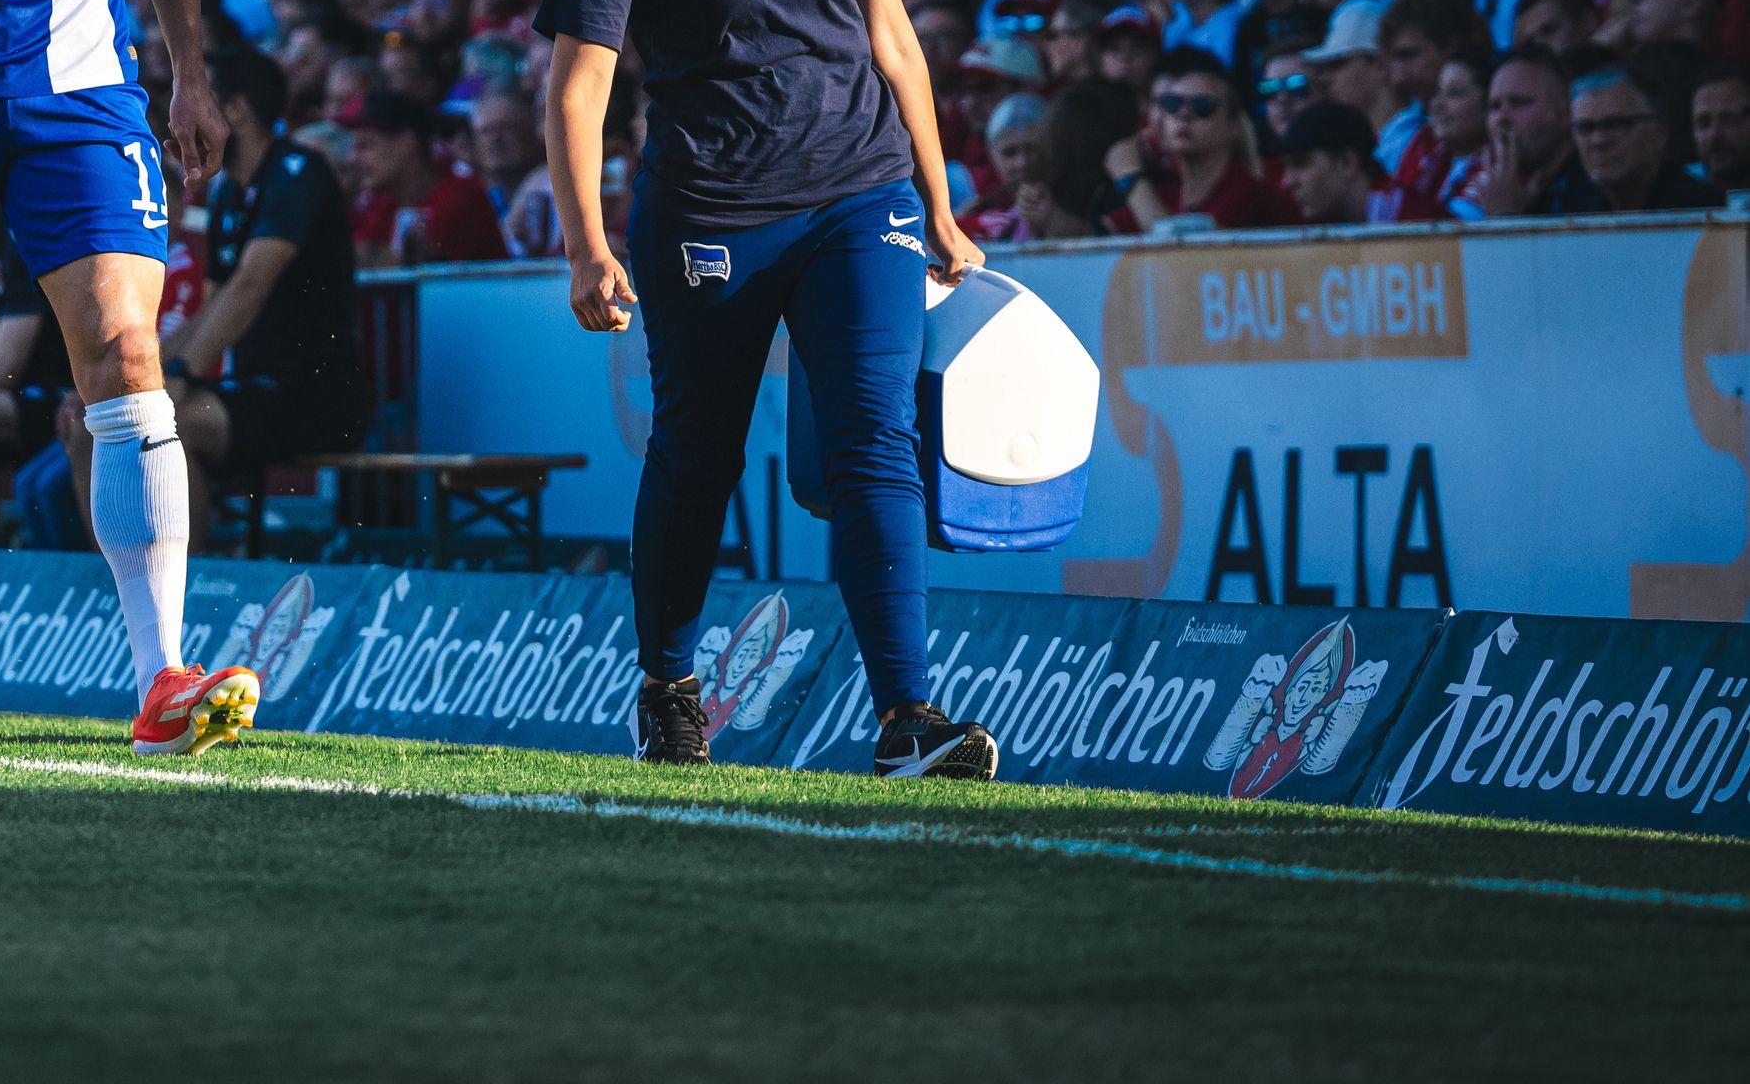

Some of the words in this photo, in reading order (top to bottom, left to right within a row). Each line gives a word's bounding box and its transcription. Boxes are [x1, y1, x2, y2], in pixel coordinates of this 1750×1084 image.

[1201, 270, 1285, 344] BAU
[1318, 262, 1447, 340] GMBH
[1206, 444, 1452, 608] ALTA
